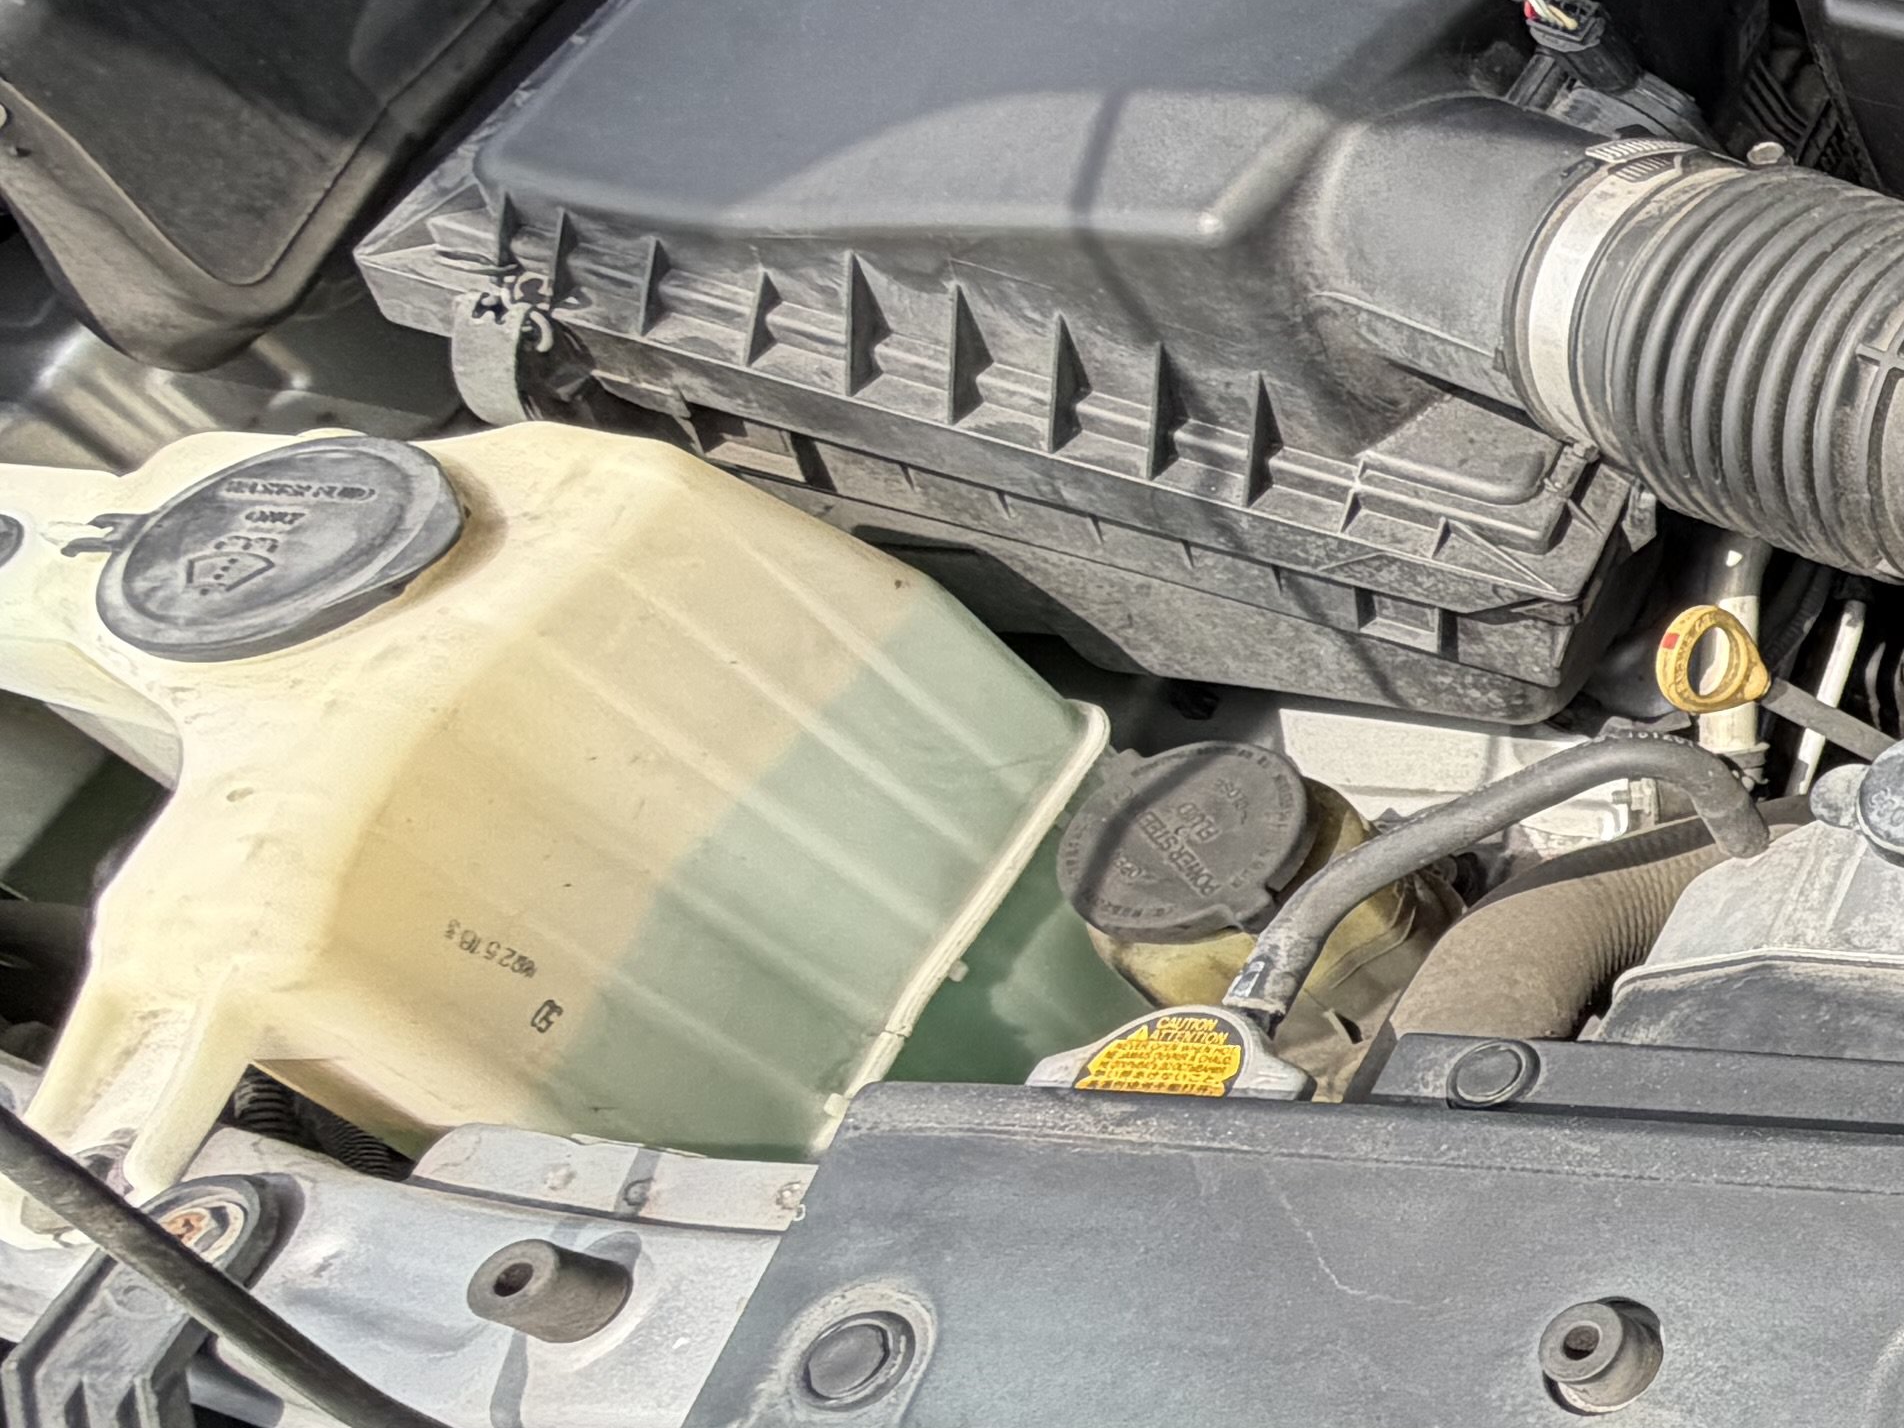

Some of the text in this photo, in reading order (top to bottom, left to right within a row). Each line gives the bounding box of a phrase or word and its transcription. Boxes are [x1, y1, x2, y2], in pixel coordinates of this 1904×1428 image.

[1170, 844, 1219, 898] POWER
[1156, 1015, 1219, 1032] CAUTION
[1149, 1029, 1230, 1045] ATTENTION
